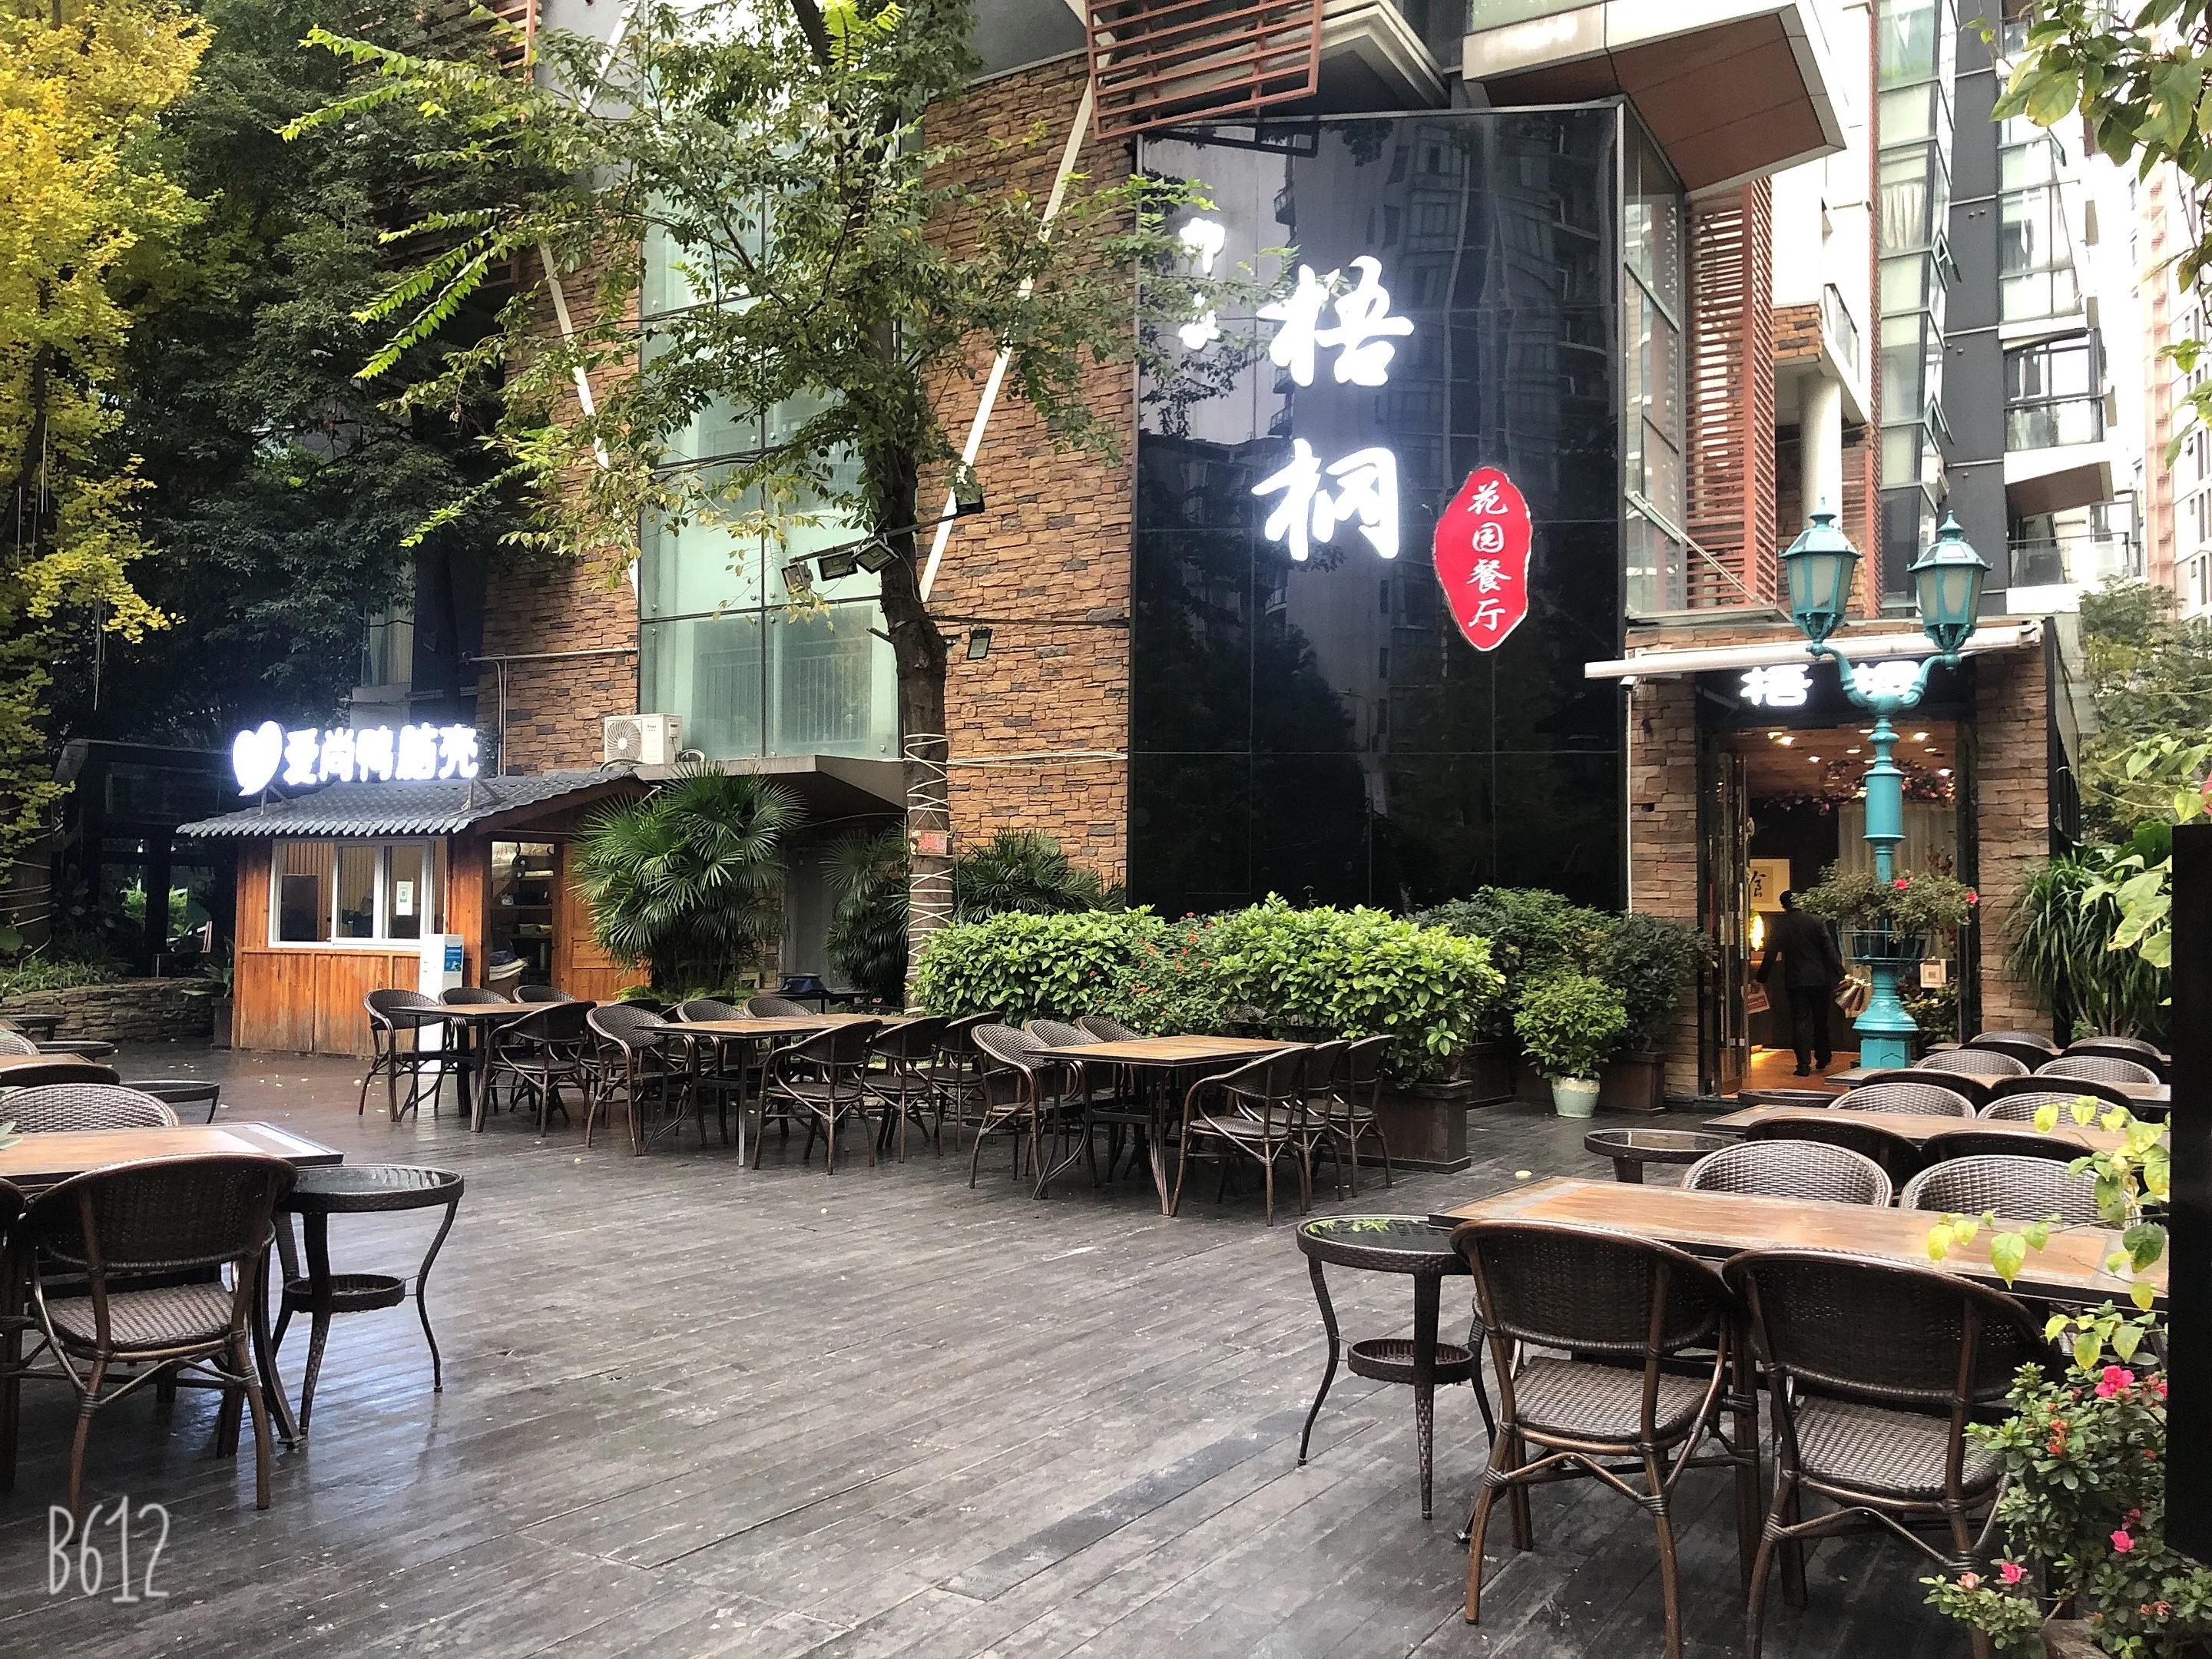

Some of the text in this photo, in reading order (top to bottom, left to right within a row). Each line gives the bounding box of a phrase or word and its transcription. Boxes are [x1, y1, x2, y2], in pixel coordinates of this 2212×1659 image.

[1251, 255, 1414, 561] 梧桐
[1465, 482, 1512, 632] 花园餐厅
